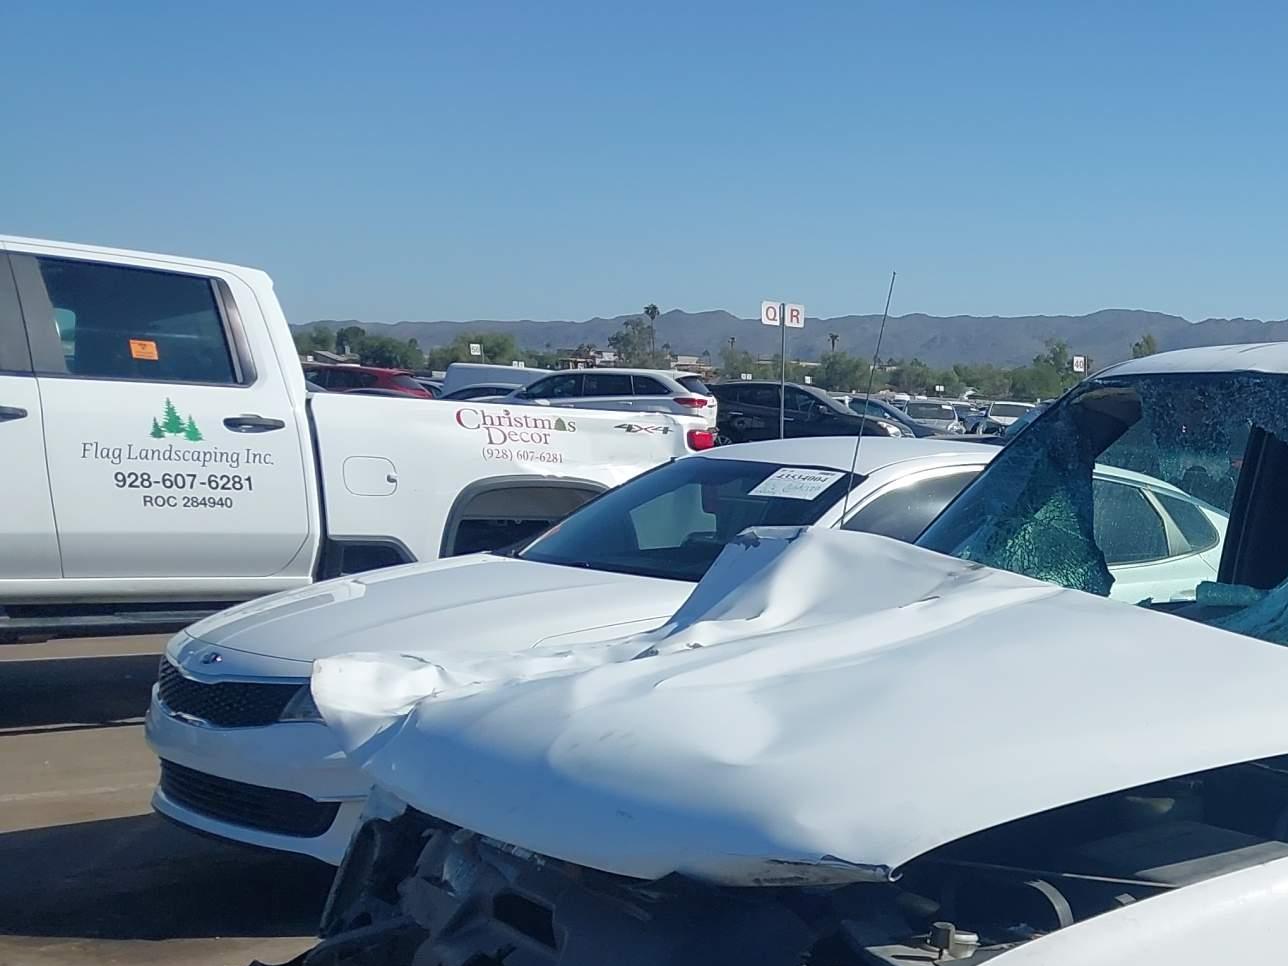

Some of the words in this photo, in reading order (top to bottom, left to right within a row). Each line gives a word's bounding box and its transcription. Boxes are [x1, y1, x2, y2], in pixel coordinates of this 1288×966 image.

[765, 305, 778, 321] Q
[790, 308, 801, 323] R
[483, 426, 551, 446] Decor
[80, 441, 122, 465] Flag
[127, 444, 240, 468] Landscaping
[245, 448, 274, 465] Inc.
[482, 447, 513, 462] (928)
[516, 449, 563, 463] 607-6281
[114, 471, 253, 491] 928-607-6281
[143, 495, 178, 508] ROC
[182, 496, 233, 508] 284940
